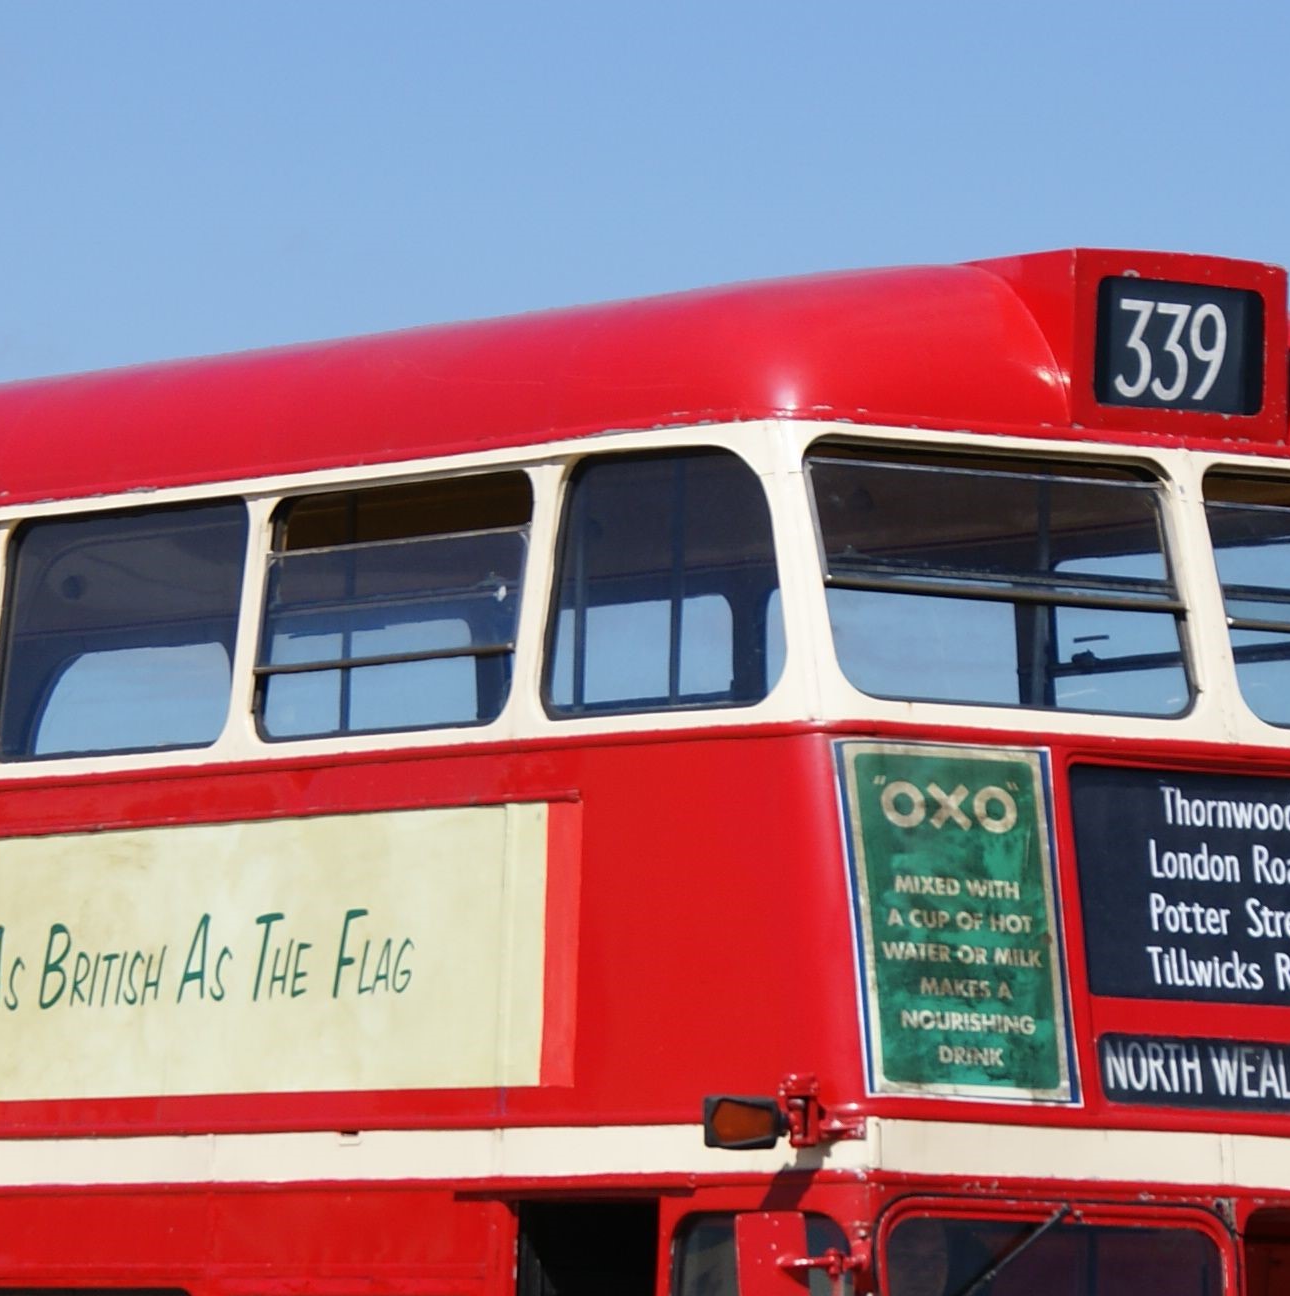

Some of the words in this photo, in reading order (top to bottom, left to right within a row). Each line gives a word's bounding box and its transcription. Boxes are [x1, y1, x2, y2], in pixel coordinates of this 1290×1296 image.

[1113, 298, 1227, 401] 339
[1149, 838, 1241, 883] London
[894, 874, 961, 896] MIXED
[965, 879, 1021, 900] WITH
[887, 908, 905, 927] A
[908, 908, 950, 929] CUP
[955, 911, 984, 931] OF
[989, 914, 1033, 934] HOT
[1149, 892, 1231, 936] Potter
[881, 941, 952, 962] WATER
[956, 944, 989, 965] OR
[993, 948, 1043, 968] MILK
[1145, 945, 1264, 990] Tillwicks
[920, 976, 991, 998] MAKES
[997, 981, 1014, 1000] A
[900, 1009, 1037, 1036] NOURISHING
[938, 1045, 1005, 1067] DRINK
[1105, 1040, 1204, 1095] NORTH
